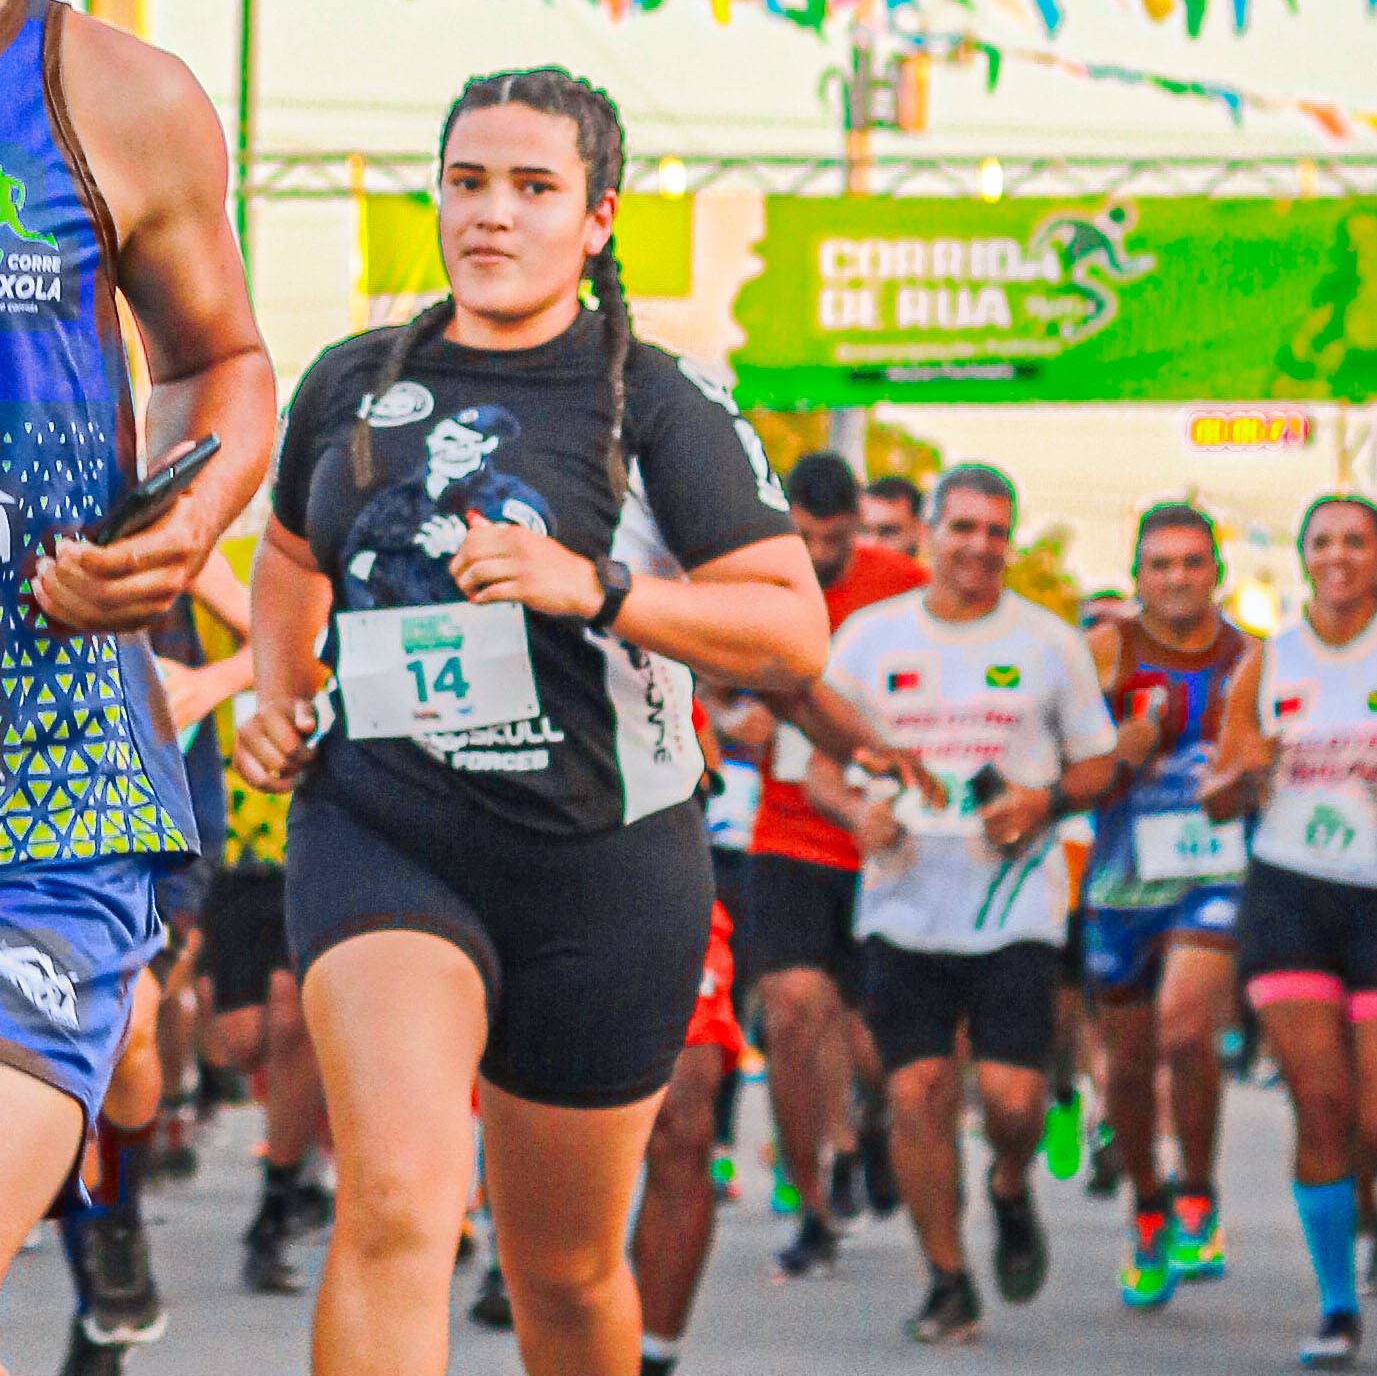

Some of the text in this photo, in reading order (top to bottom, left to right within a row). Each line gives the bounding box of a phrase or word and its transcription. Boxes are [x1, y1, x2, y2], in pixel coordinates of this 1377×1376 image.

[8, 253, 61, 273] CORRE
[820, 238, 1060, 282] CORRIDA
[897, 287, 1012, 330] RUA
[406, 657, 469, 702] 14
